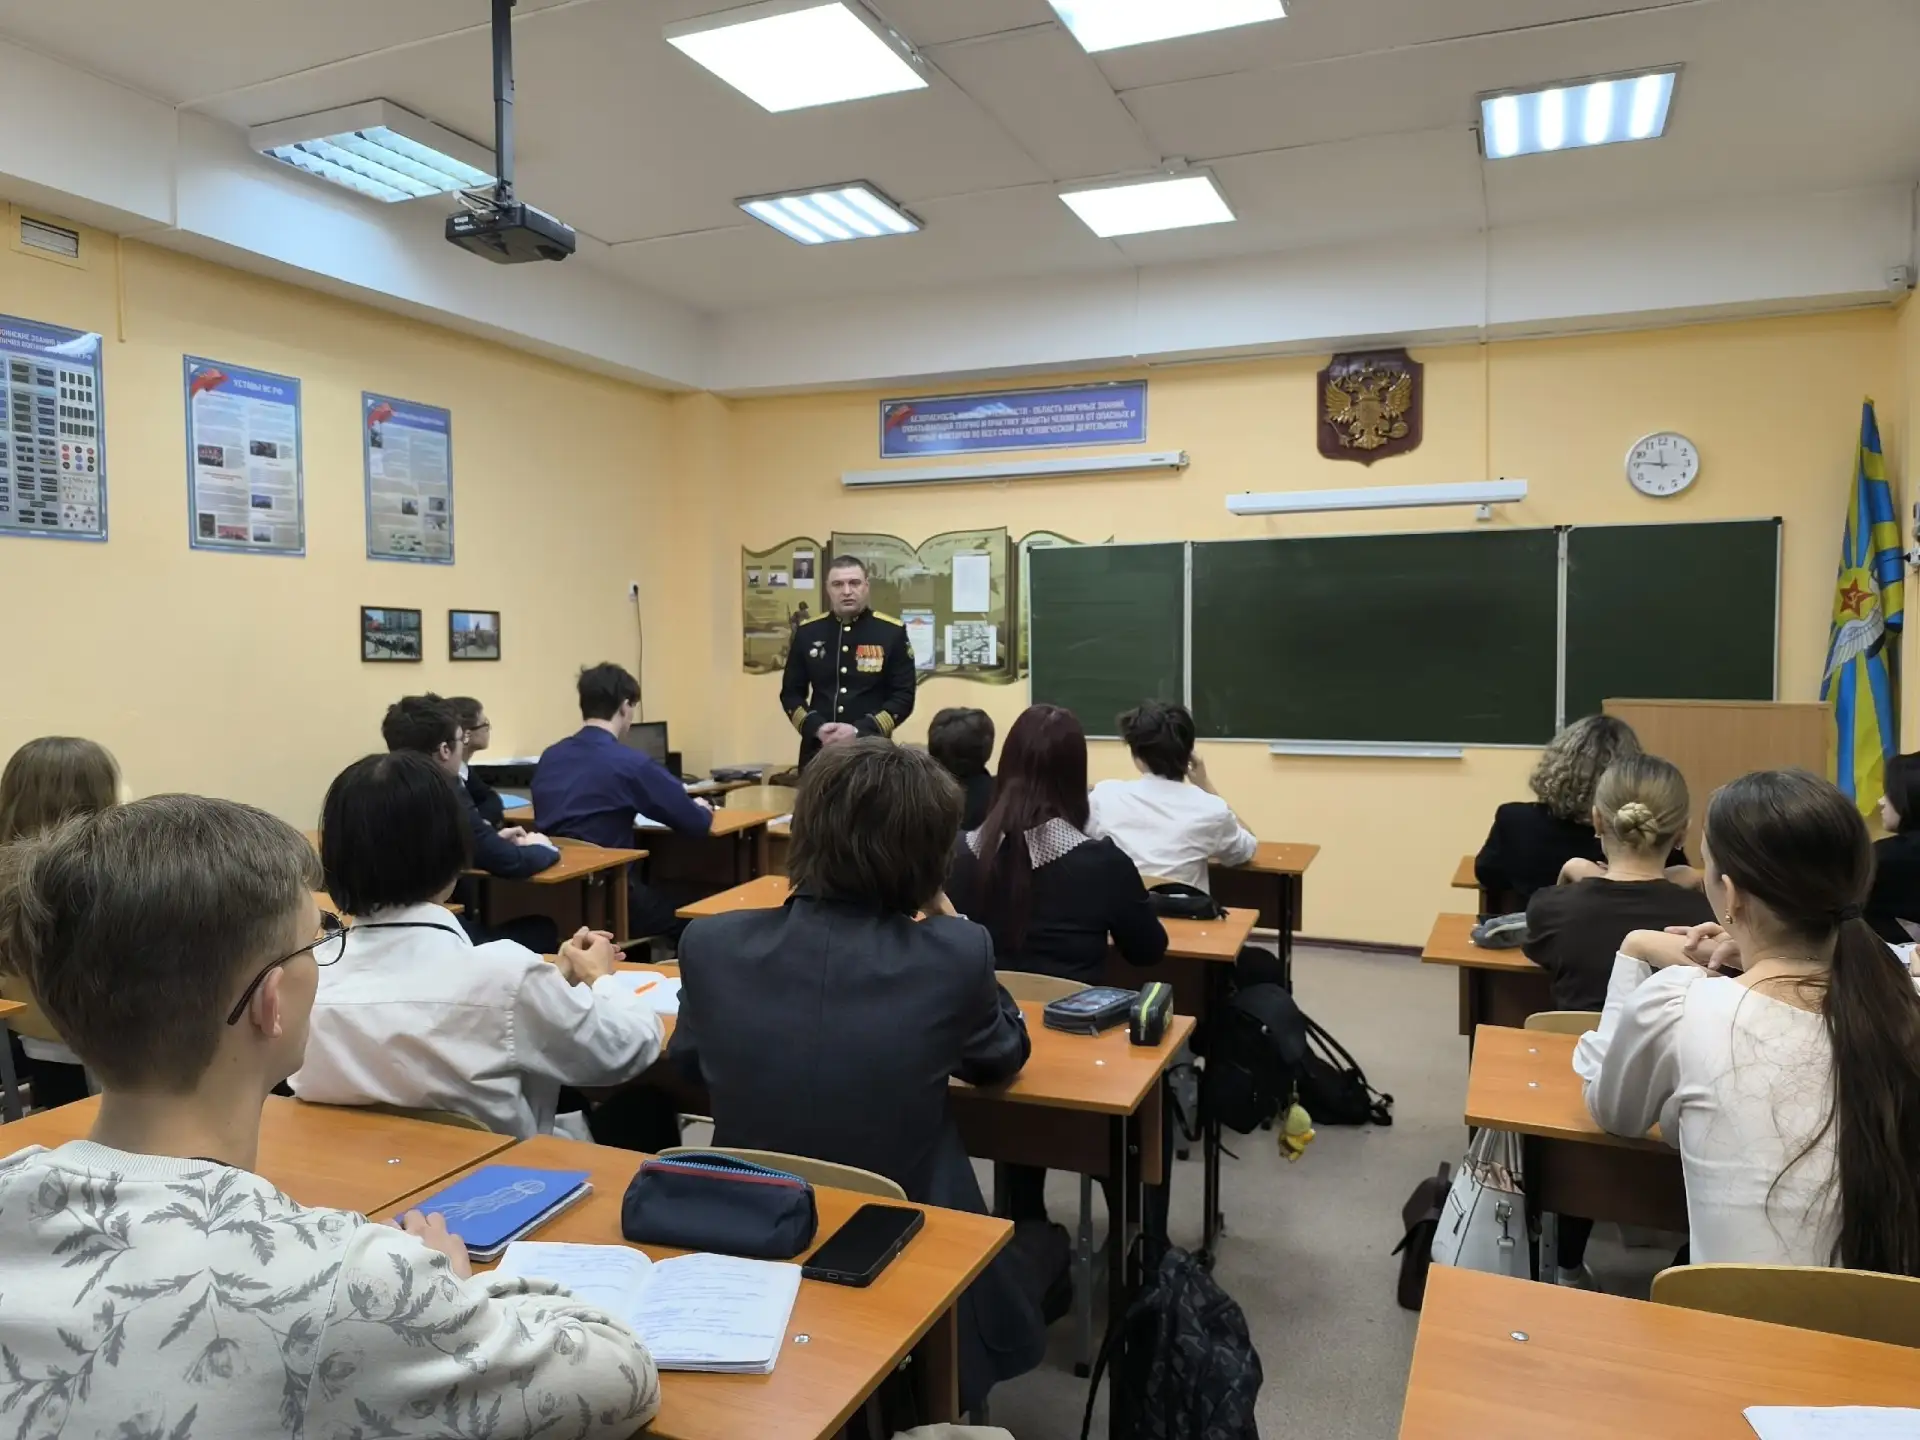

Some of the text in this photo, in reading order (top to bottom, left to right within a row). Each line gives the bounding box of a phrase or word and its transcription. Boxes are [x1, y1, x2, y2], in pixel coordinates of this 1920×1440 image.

[1033, 405, 1062, 414] ОБЛАСТЬ
[1052, 413, 1084, 422] ЧЕЛОВЕКА
[1086, 412, 1094, 420] ОТ
[1096, 410, 1129, 420] ОПАСНЫХ
[1658, 437, 1668, 446] 12
[1680, 448, 1688, 456] 2
[1684, 459, 1691, 467] 3
[1638, 472, 1644, 481] 8
[1671, 479, 1678, 488] 5
